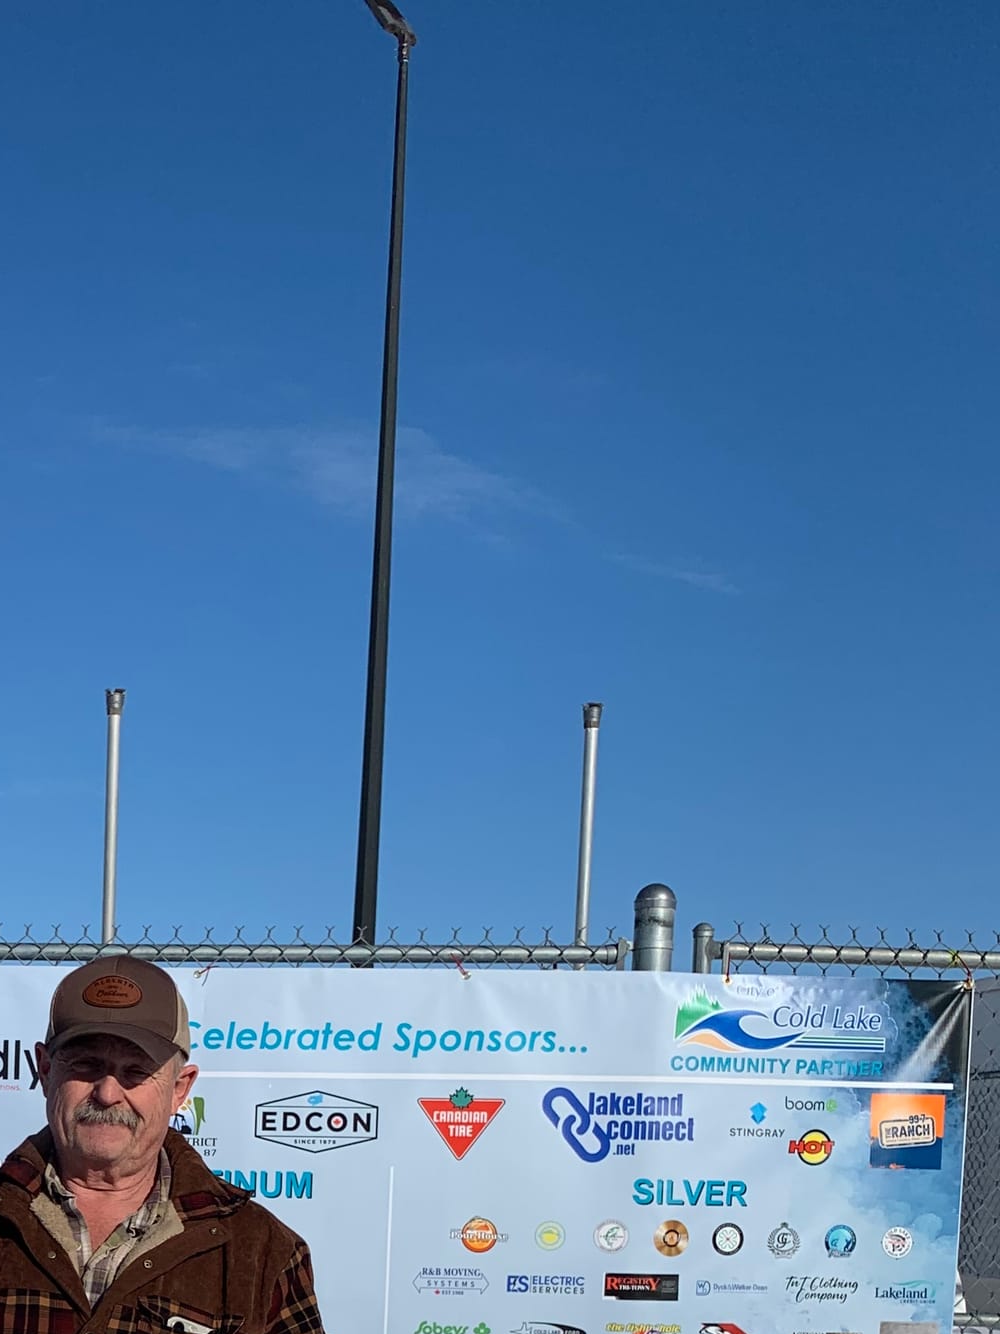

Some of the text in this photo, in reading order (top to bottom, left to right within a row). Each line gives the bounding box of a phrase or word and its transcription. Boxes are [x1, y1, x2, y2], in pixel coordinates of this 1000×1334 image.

[773, 1004, 881, 1031] Cold Lake
[393, 1023, 588, 1058] Sponsors...
[670, 1055, 884, 1077] COMMUNITY PARTNER
[589, 1092, 684, 1116] lakeland
[785, 1096, 825, 1111] boom
[261, 1110, 372, 1133] EDCON
[433, 1110, 488, 1124] CANADIAN
[448, 1124, 474, 1138] TIRE
[607, 1118, 694, 1141] connect
[729, 1128, 785, 1138] STINGRAY
[891, 1124, 930, 1138] RANCH
[203, 1148, 217, 1157] 87
[613, 1143, 636, 1156] .net
[788, 1139, 835, 1154] HOT
[212, 1169, 313, 1199] INUM
[632, 1178, 748, 1207] SILVER
[443, 1267, 482, 1277] MOVING
[532, 1275, 585, 1287] ELECTRIC
[606, 1276, 661, 1291] REGISTRY
[810, 1276, 859, 1294] Clothing
[532, 1286, 585, 1295] SERVICES
[795, 1290, 848, 1304] Company
[874, 1287, 928, 1300] Lakeland
